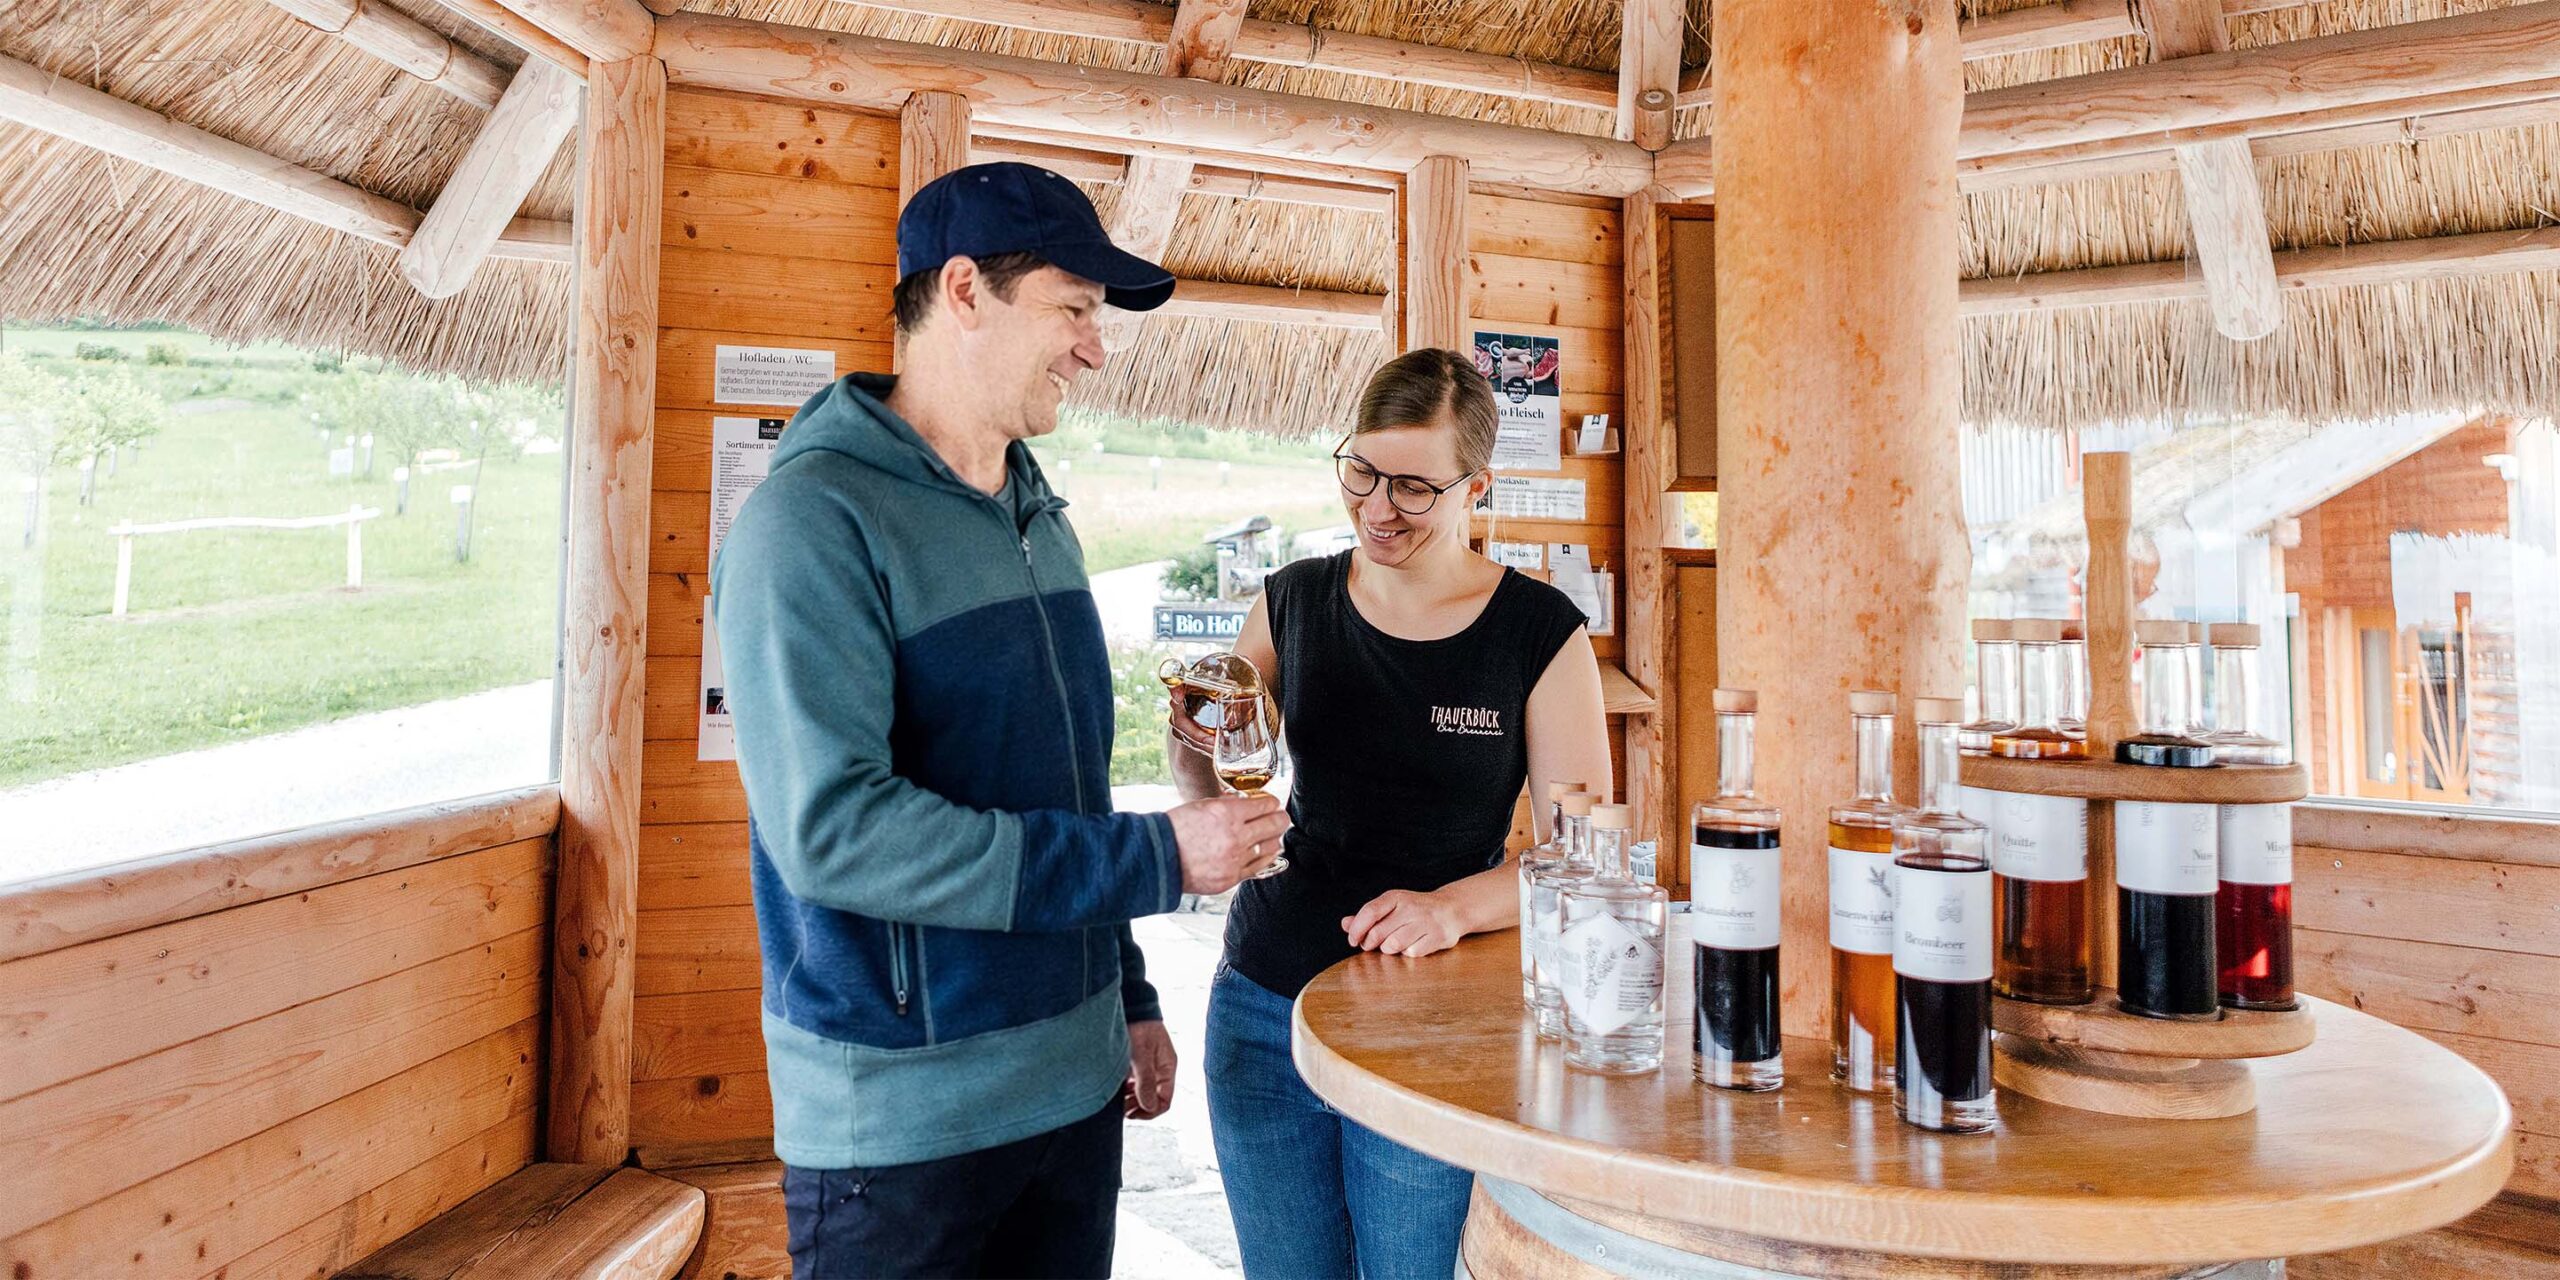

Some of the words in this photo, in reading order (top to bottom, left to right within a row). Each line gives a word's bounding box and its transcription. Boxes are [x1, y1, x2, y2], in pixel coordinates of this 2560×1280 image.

[739, 352, 786, 364] Hofladen
[794, 355, 813, 365] WC
[1498, 405, 1507, 416] io
[1510, 407, 1544, 419] Fleisch
[726, 441, 764, 450] Sortiment
[1176, 613, 1204, 634] Bio
[1430, 706, 1500, 728] THAUERBÖCK
[1457, 722, 1504, 736] Brennerei
[2002, 832, 2037, 848] Quitte
[1904, 930, 1966, 950] Brombeer
